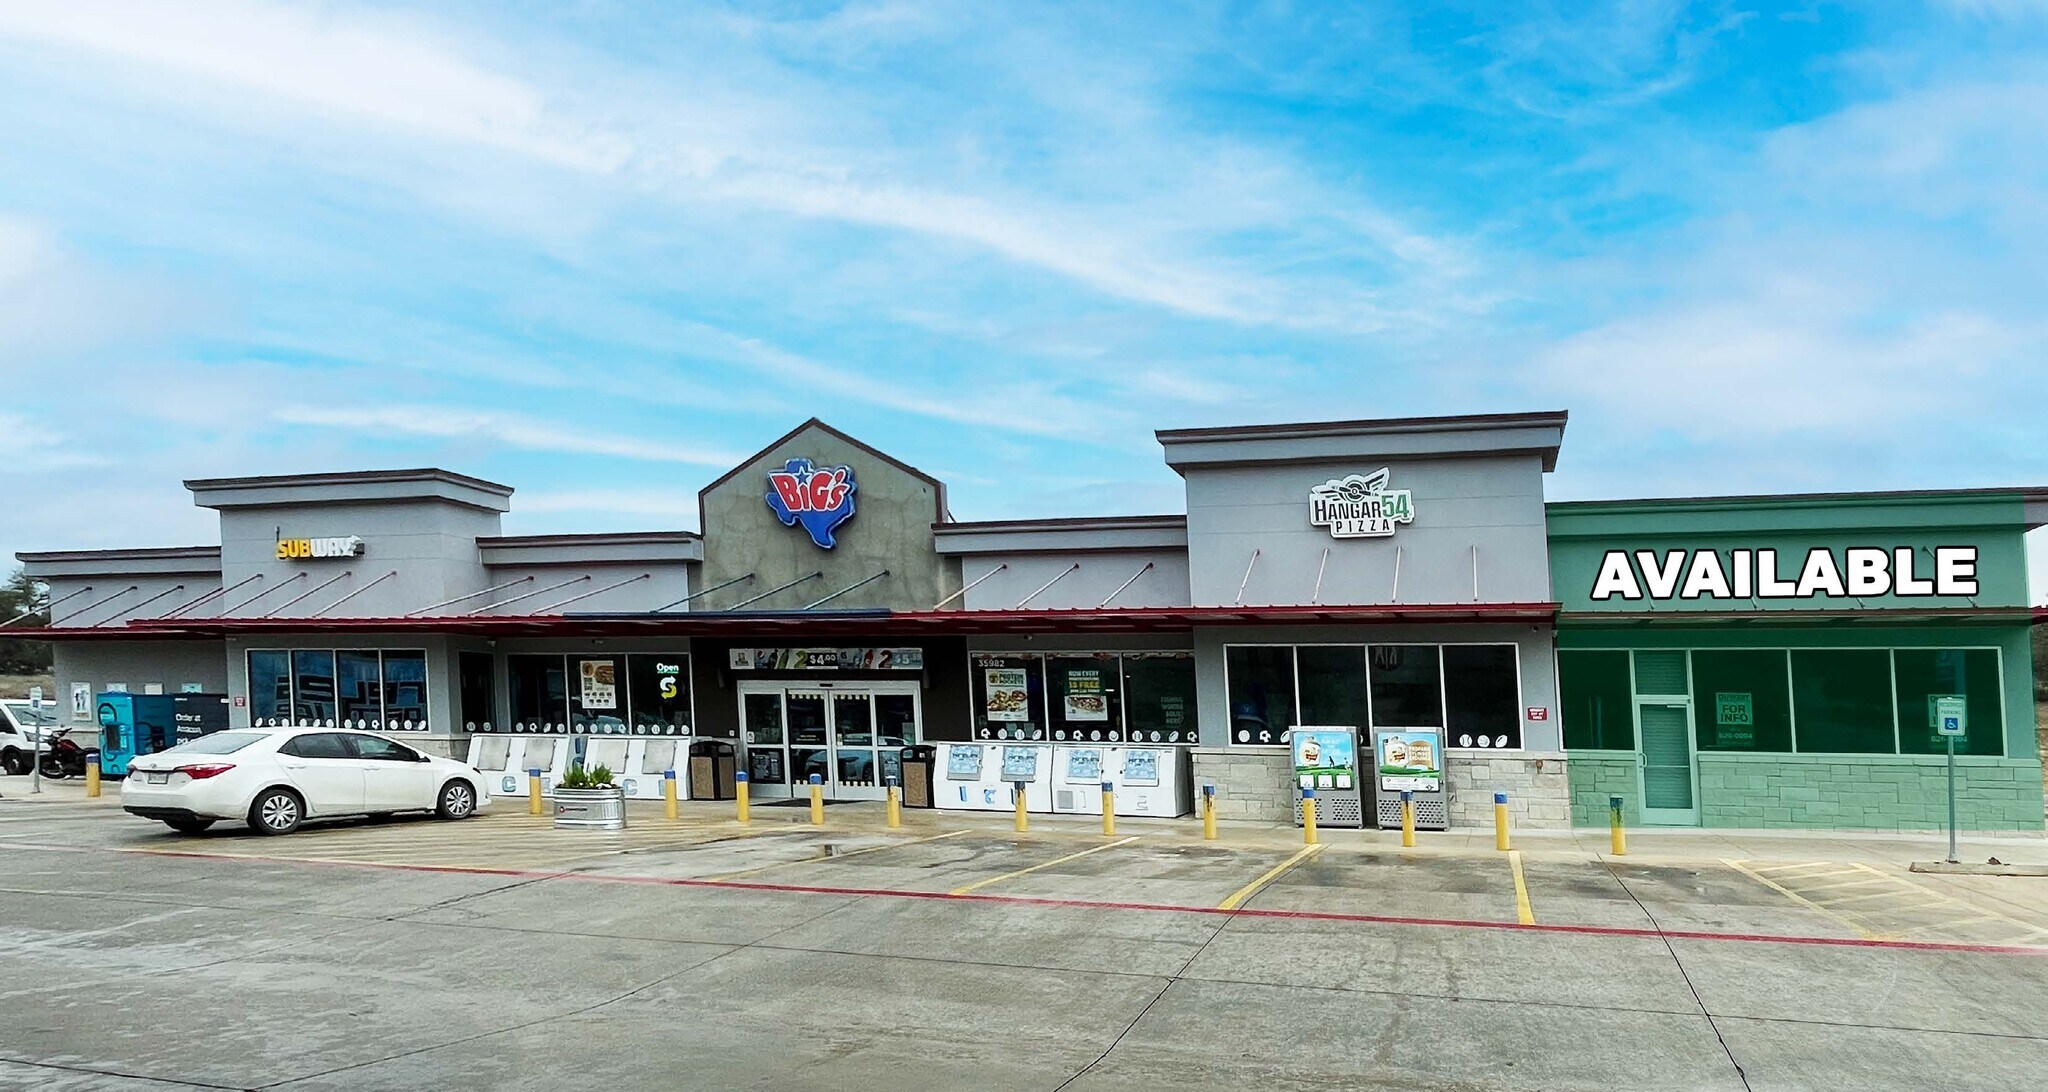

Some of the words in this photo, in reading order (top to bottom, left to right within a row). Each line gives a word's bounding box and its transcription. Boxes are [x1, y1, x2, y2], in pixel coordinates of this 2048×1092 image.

[1335, 519, 1390, 533] PIZZA
[276, 535, 362, 560] SUBWAY
[656, 663, 680, 672] Open
[1722, 704, 1746, 714] FOR
[1720, 713, 1749, 722] INFO
